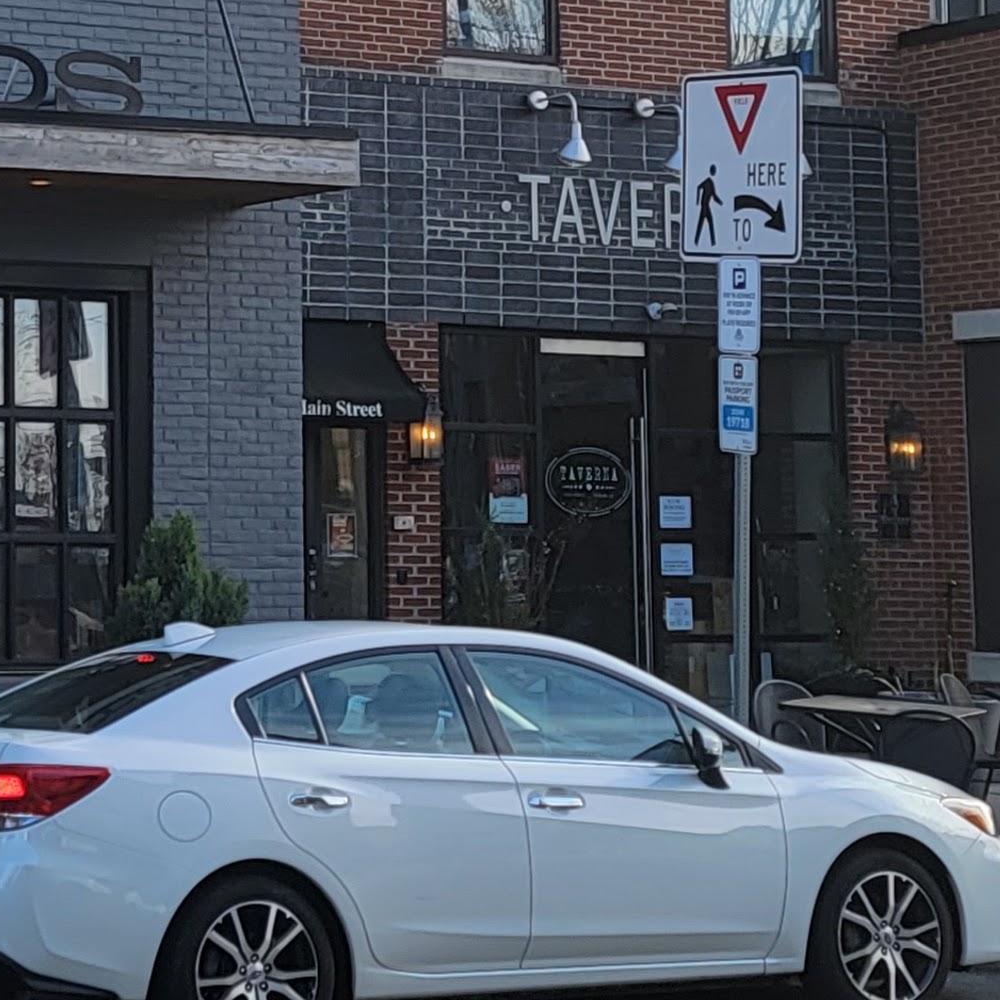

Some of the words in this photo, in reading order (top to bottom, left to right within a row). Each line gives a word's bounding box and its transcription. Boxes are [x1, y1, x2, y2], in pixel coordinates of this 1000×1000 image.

[747, 162, 787, 187] HERE
[733, 218, 752, 242] TO
[336, 399, 383, 418] Street
[559, 465, 618, 482] TAVERNA
